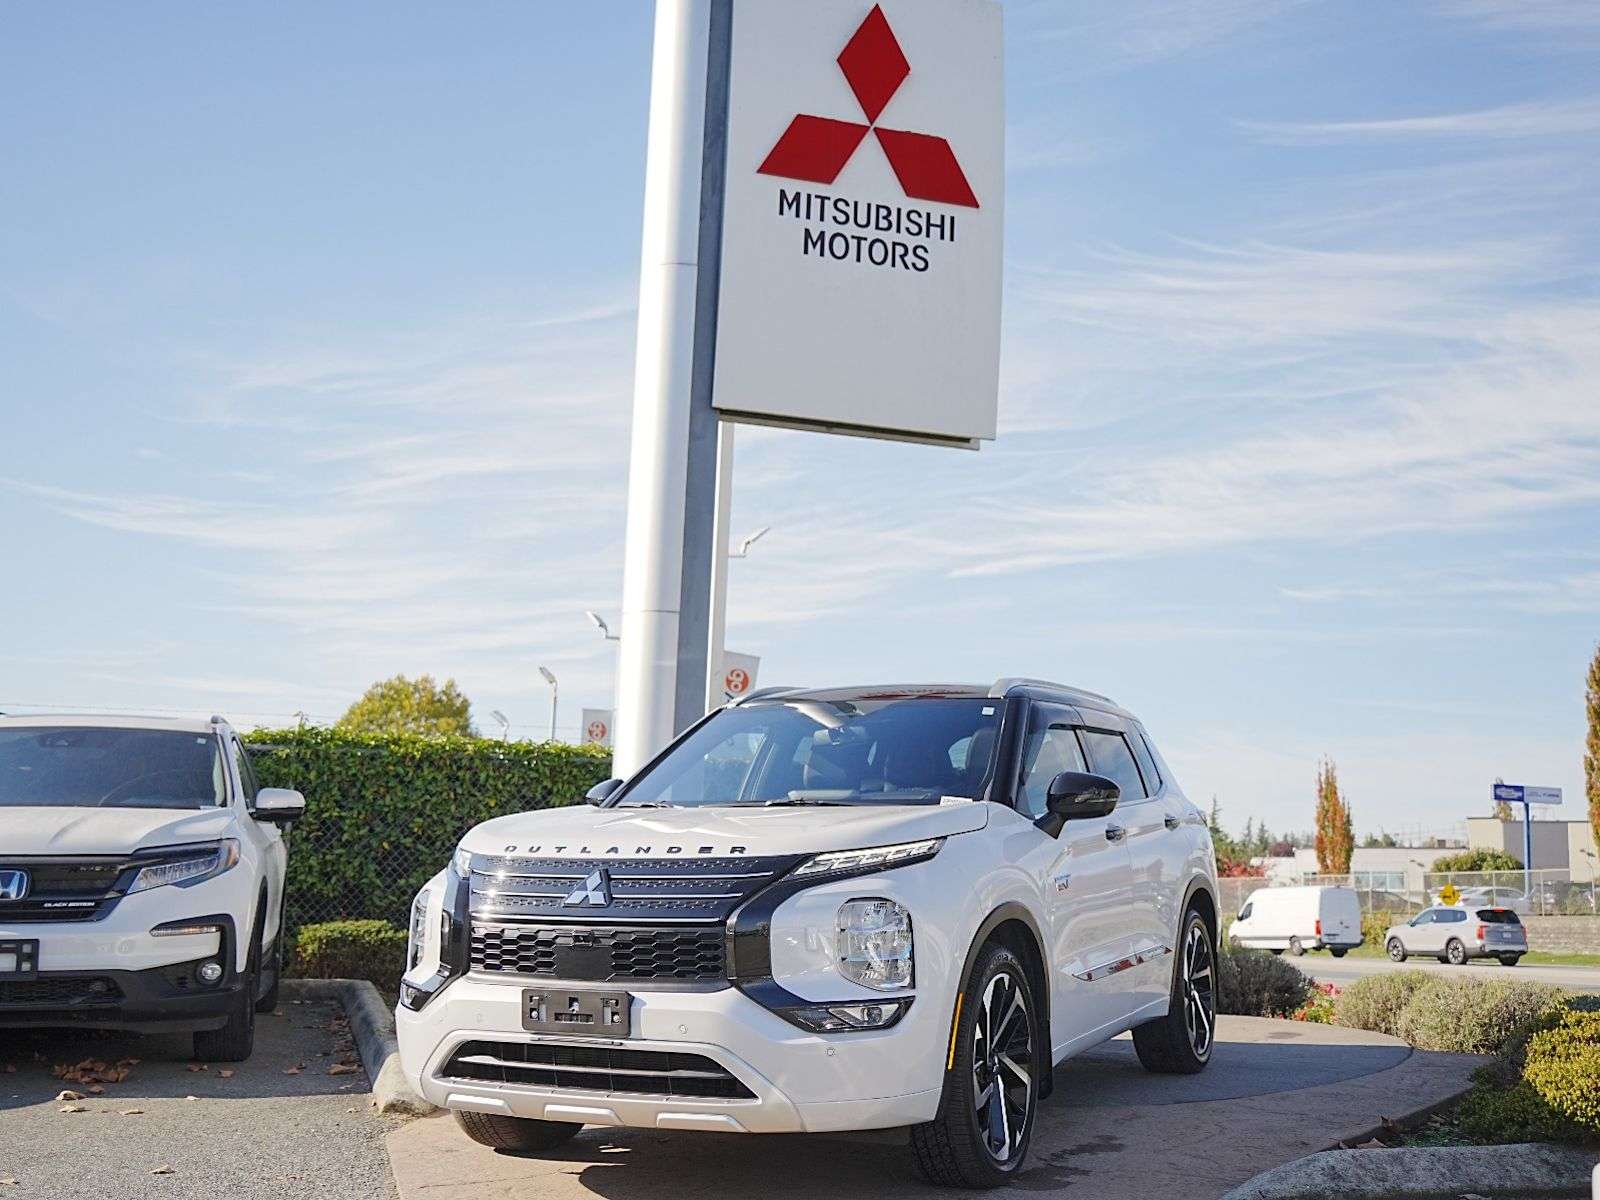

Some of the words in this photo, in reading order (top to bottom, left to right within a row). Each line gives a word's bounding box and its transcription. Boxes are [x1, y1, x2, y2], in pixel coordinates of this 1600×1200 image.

[778, 189, 955, 242] MITSUBISHI
[803, 227, 930, 272] MOTORS
[504, 845, 747, 855] OUTLANDER
